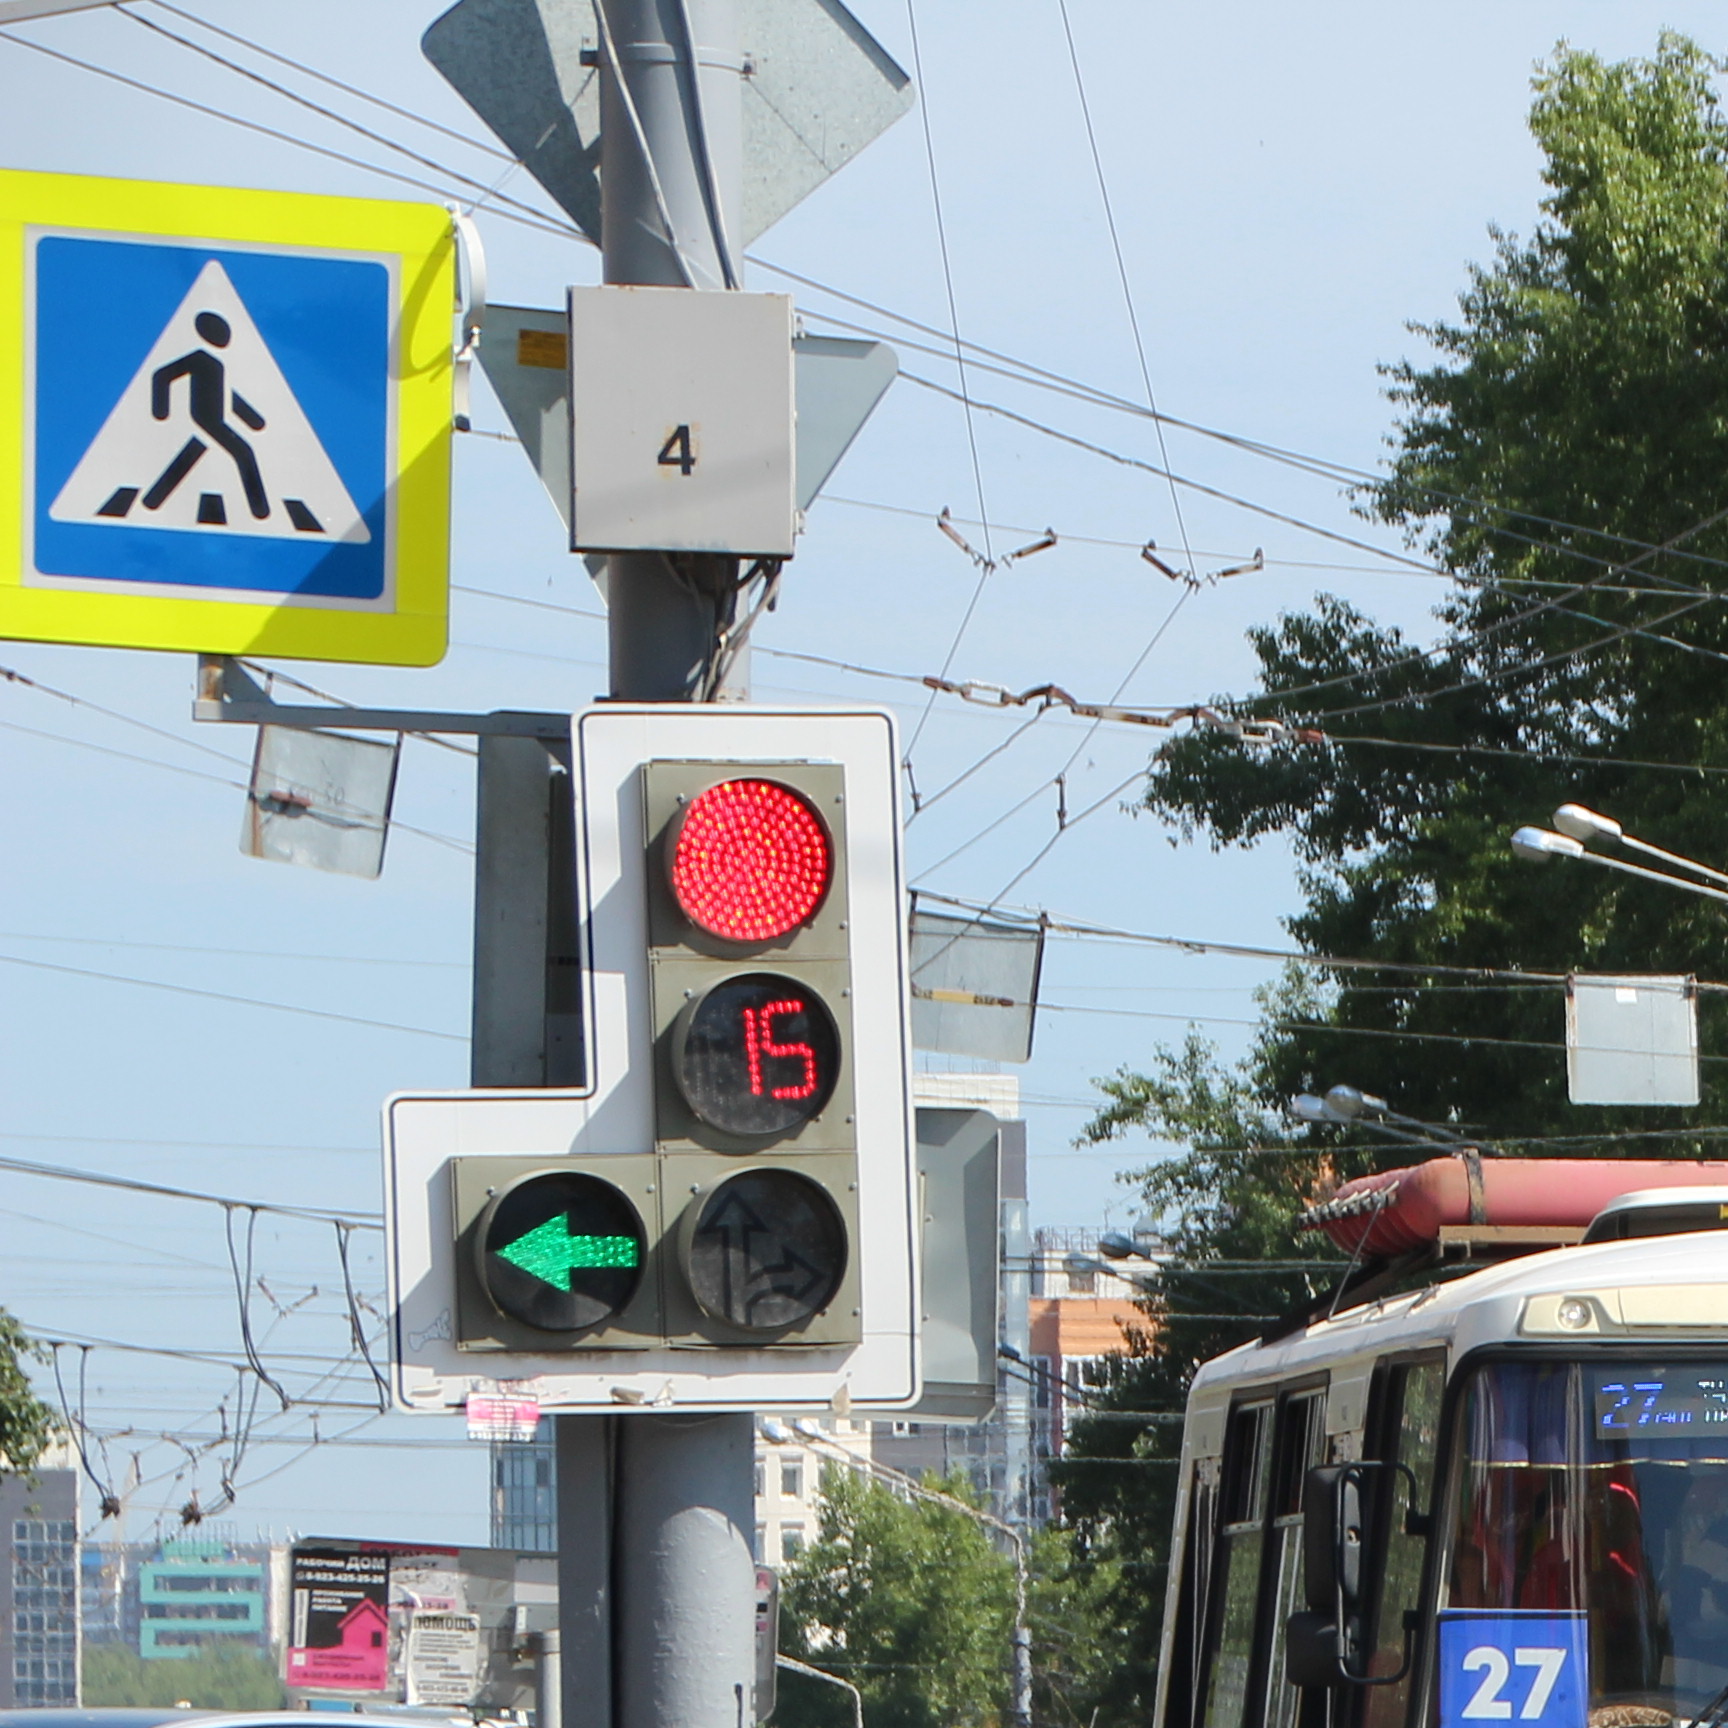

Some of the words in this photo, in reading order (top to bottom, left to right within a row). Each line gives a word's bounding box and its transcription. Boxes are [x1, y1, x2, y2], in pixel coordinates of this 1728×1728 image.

[658, 424, 696, 476] 4
[744, 1000, 816, 1099] 15
[346, 1556, 386, 1571] ДОМ
[413, 1616, 477, 1632] ПОМОЩЬ
[1461, 1646, 1567, 1719] 27
